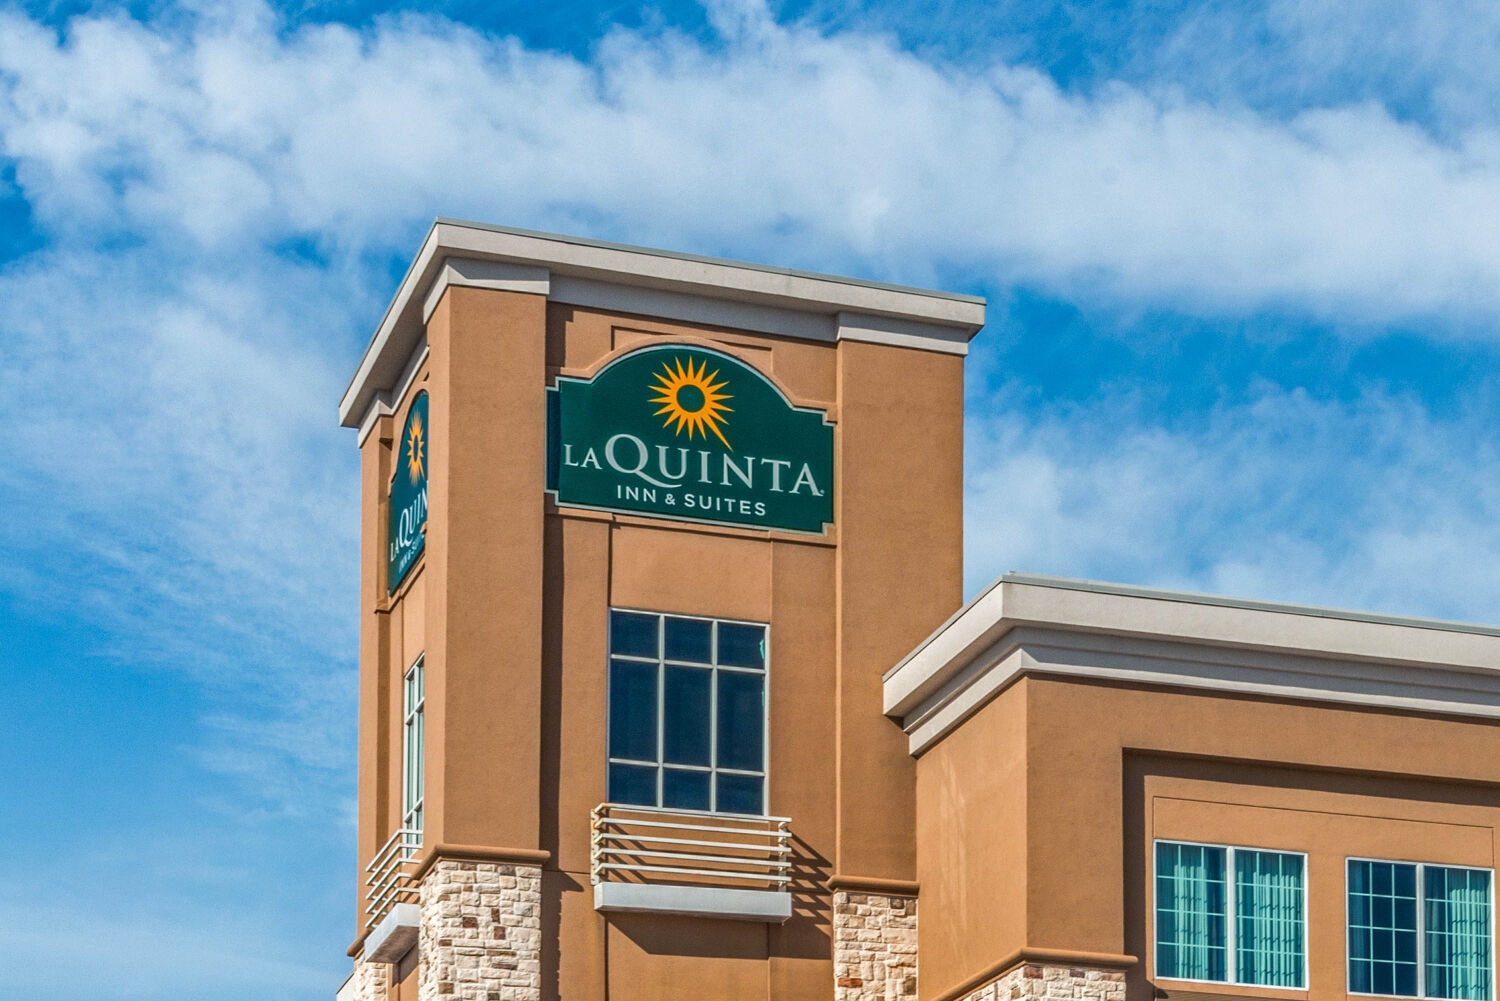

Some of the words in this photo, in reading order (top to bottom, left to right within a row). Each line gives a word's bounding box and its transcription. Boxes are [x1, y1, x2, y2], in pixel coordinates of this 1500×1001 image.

[563, 444, 603, 470] LA
[605, 433, 824, 497] QUINTA
[617, 485, 656, 503] INN
[665, 494, 675, 506] &
[684, 494, 766, 516] SUITES
[390, 536, 400, 562] LA
